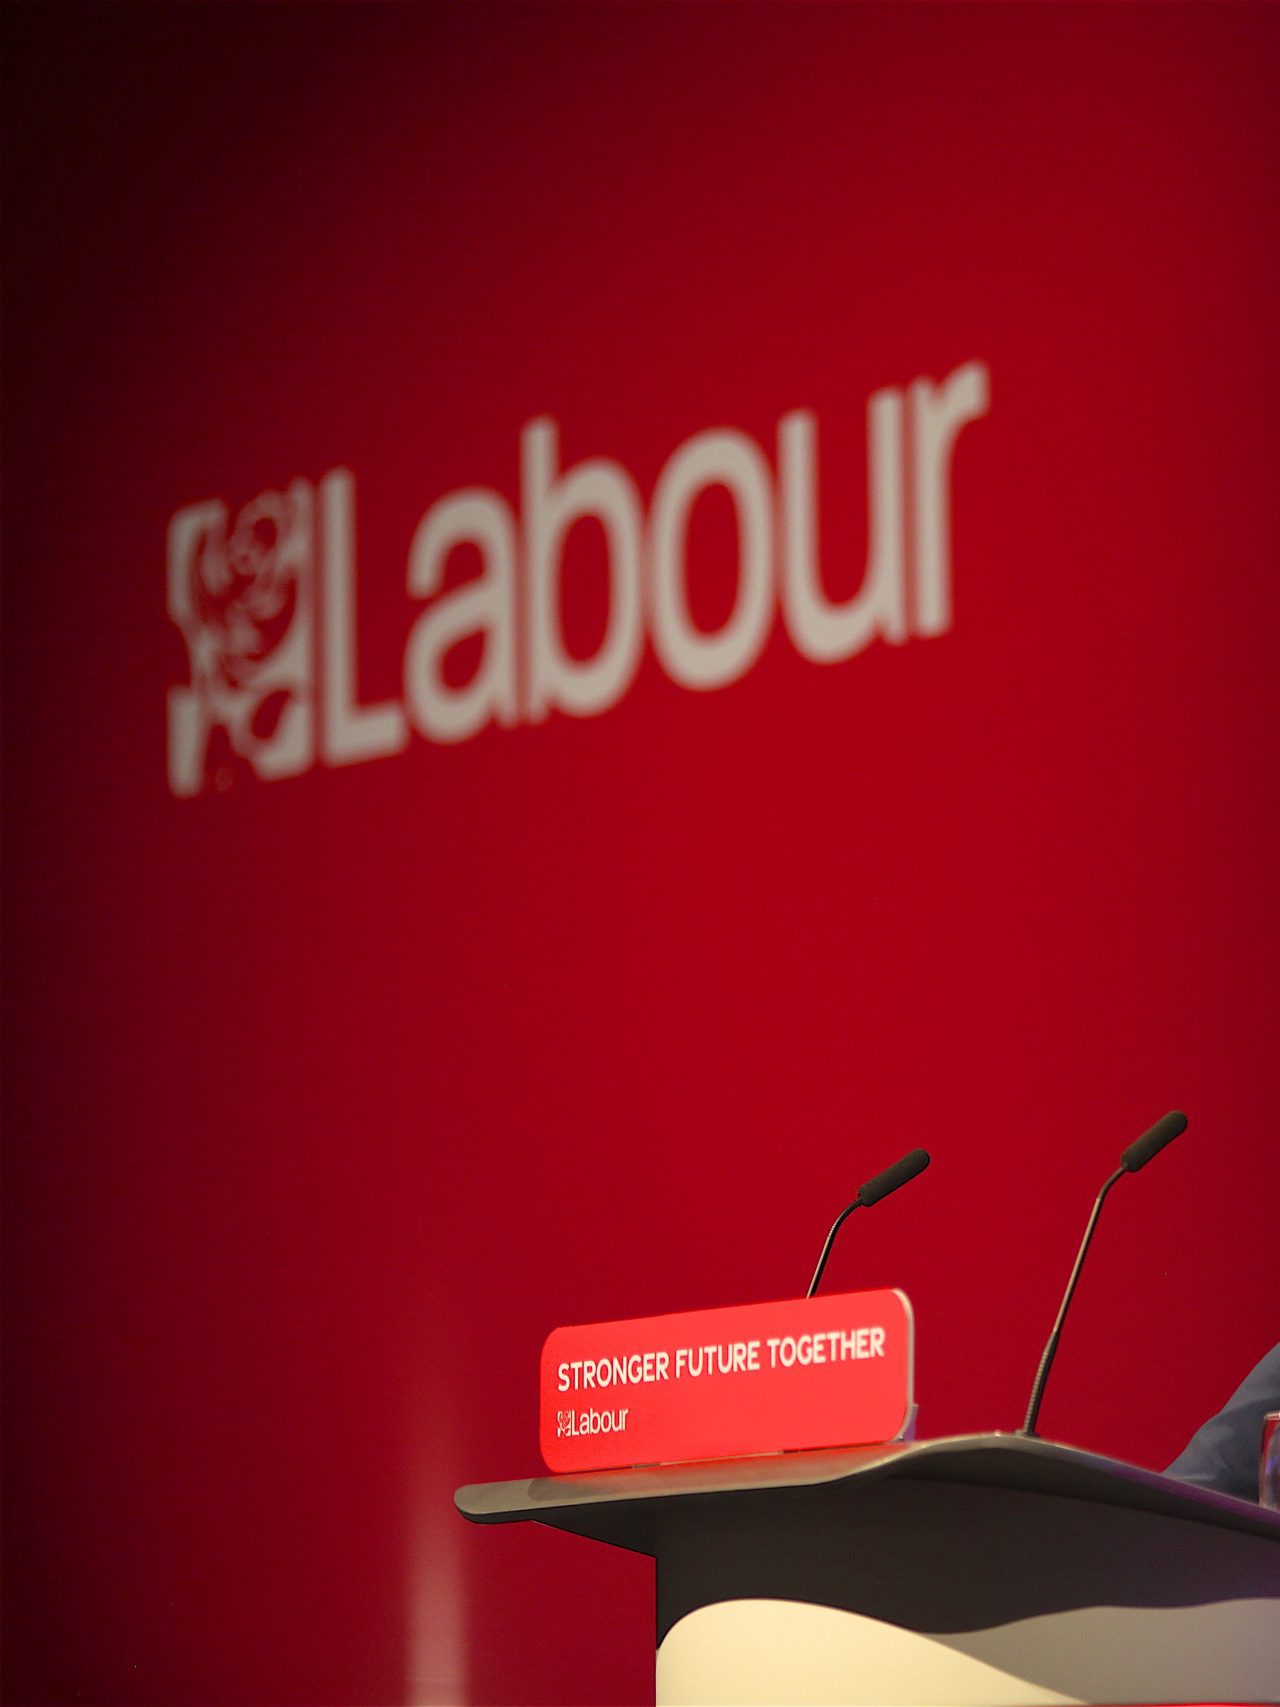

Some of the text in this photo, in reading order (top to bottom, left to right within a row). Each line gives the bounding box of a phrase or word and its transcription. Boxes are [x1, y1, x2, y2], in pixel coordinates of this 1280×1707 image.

[320, 359, 989, 767] Labour
[557, 1327, 886, 1392] STRONGER FUTURE TOGETHER
[572, 1408, 628, 1436] Labour
